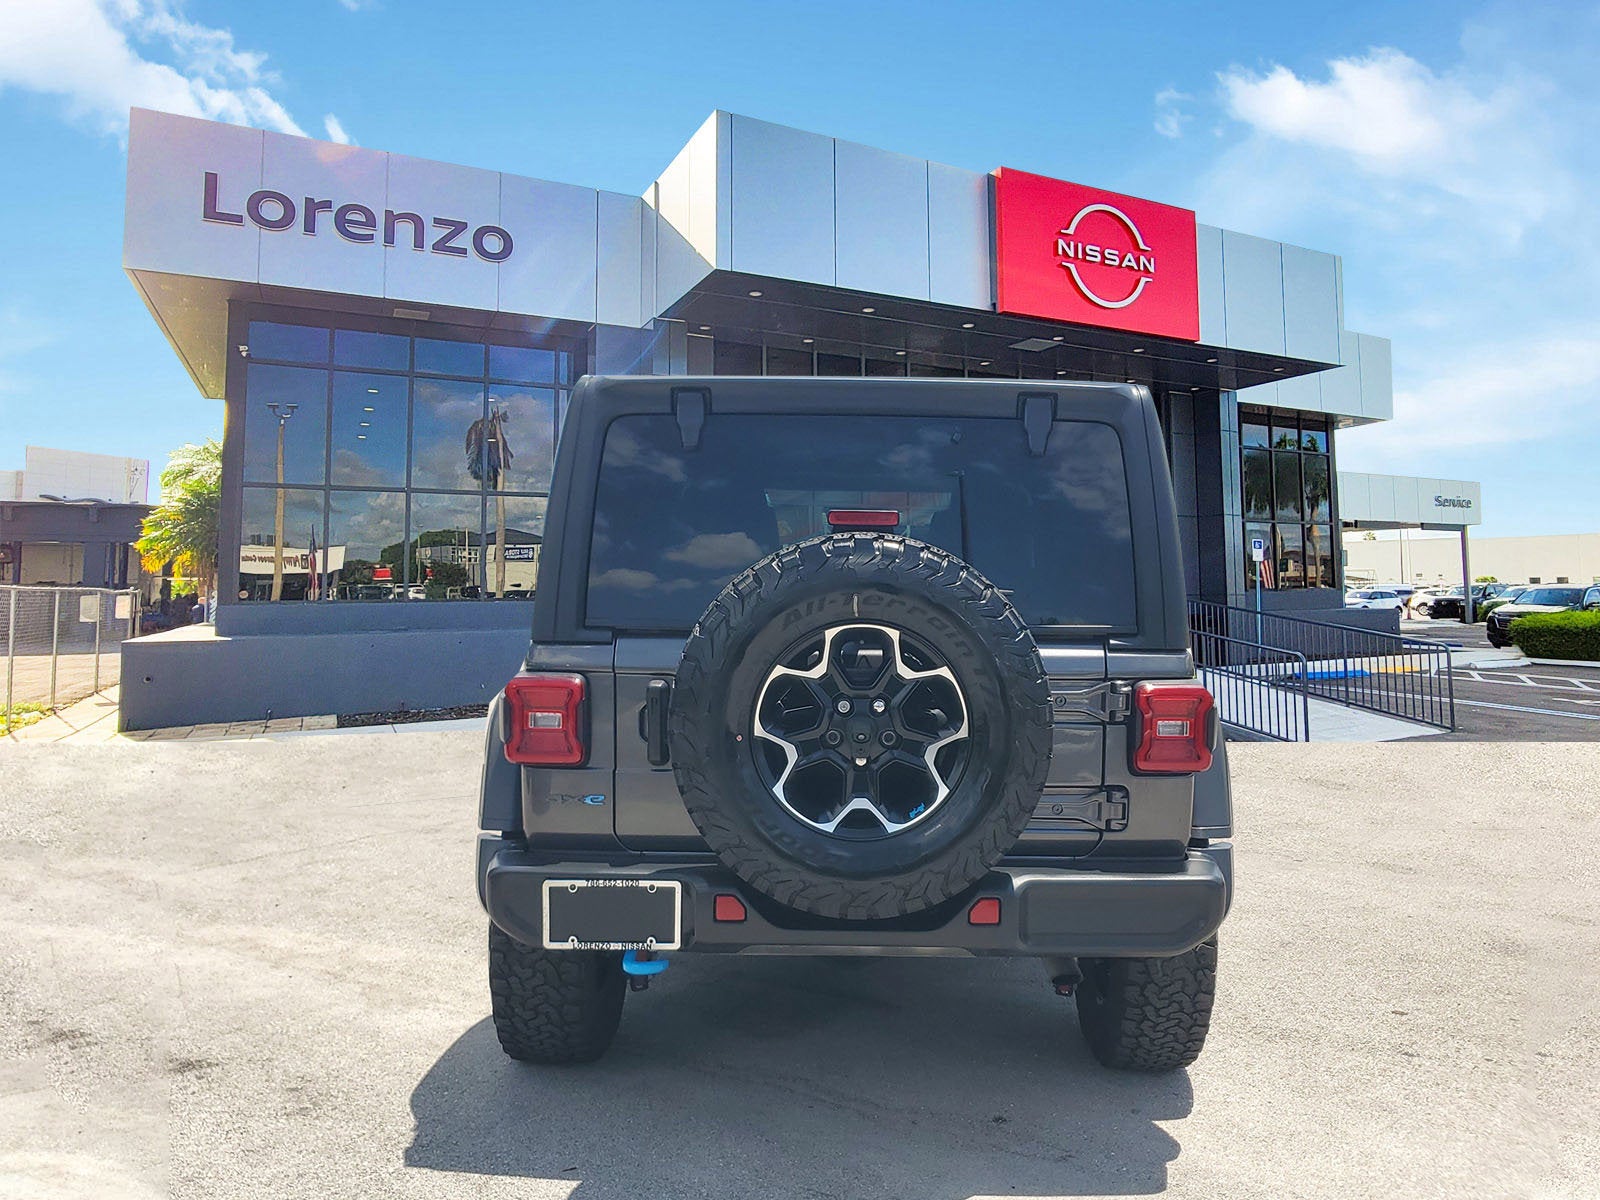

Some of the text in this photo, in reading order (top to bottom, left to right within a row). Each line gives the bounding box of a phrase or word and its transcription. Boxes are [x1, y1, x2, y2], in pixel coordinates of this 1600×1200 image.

[203, 171, 514, 262] Lorenzo
[1057, 238, 1155, 273] NISSAN
[1435, 495, 1472, 508] Service
[573, 942, 652, 950] LORENZO NISSAN
